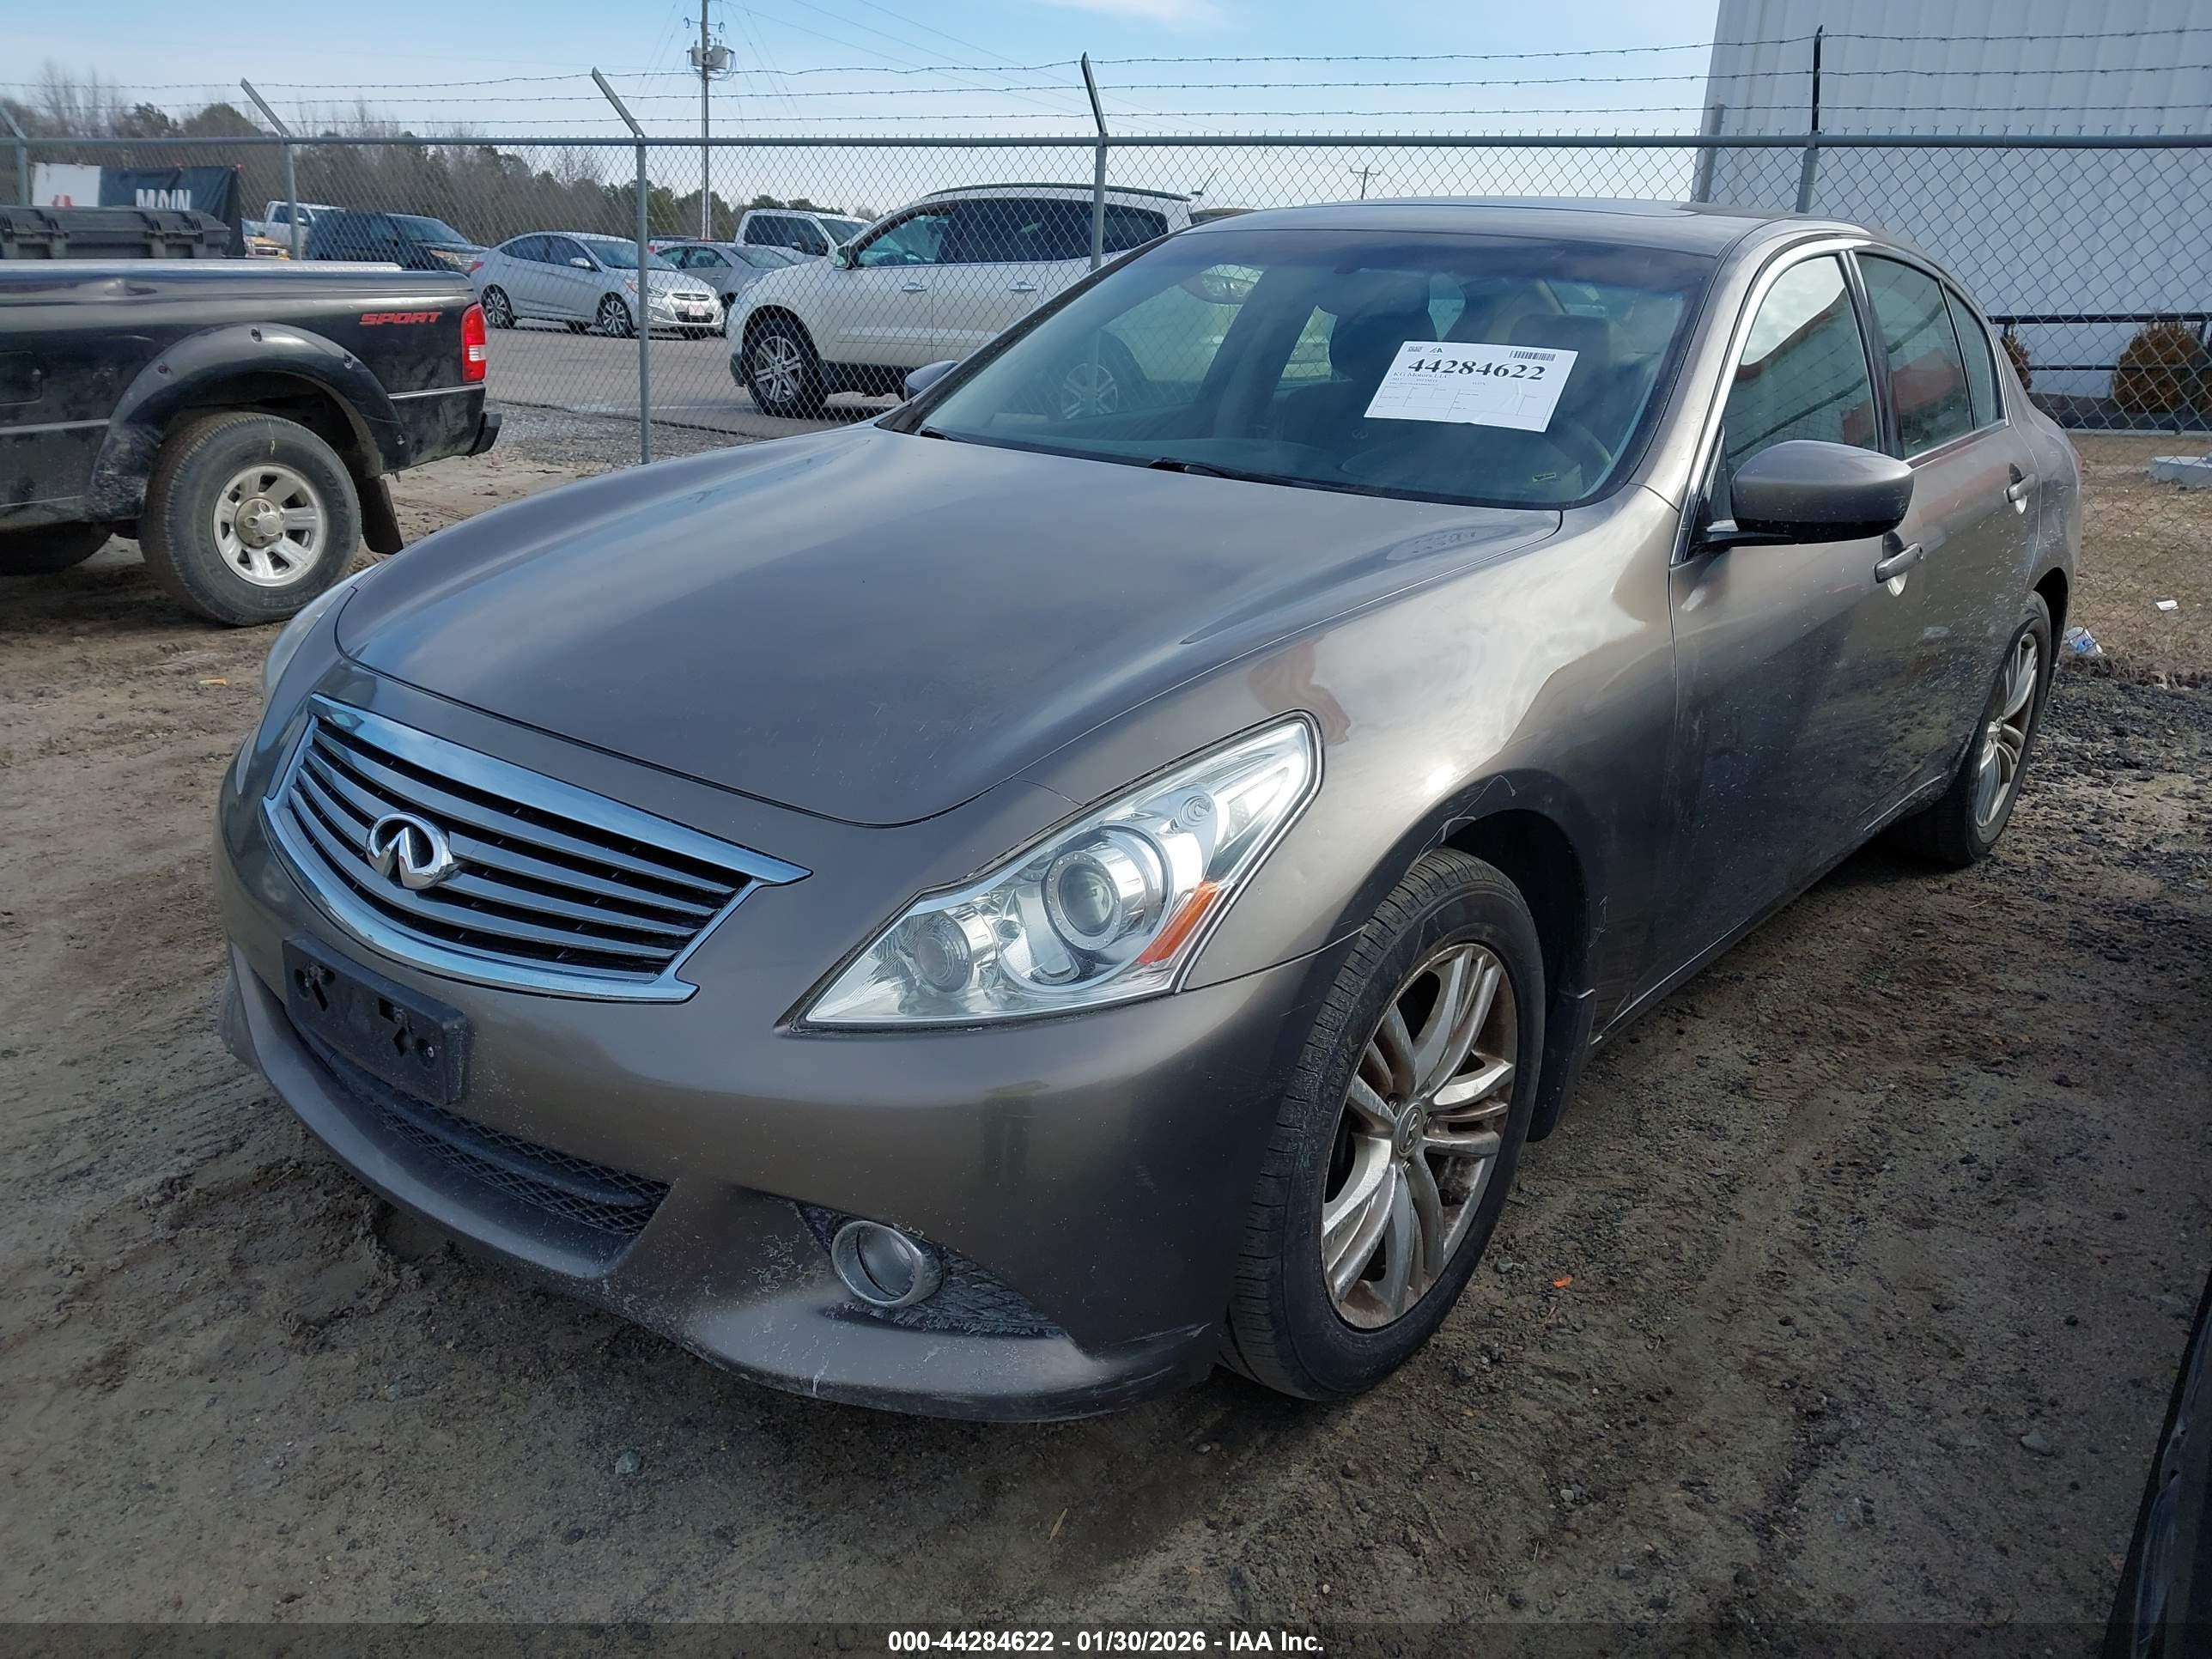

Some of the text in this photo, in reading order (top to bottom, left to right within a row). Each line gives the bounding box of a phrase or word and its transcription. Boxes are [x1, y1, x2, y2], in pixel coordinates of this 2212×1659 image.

[136, 189, 191, 211] MAIN
[359, 312, 442, 325] SPORT
[1407, 358, 1546, 380] 44284622
